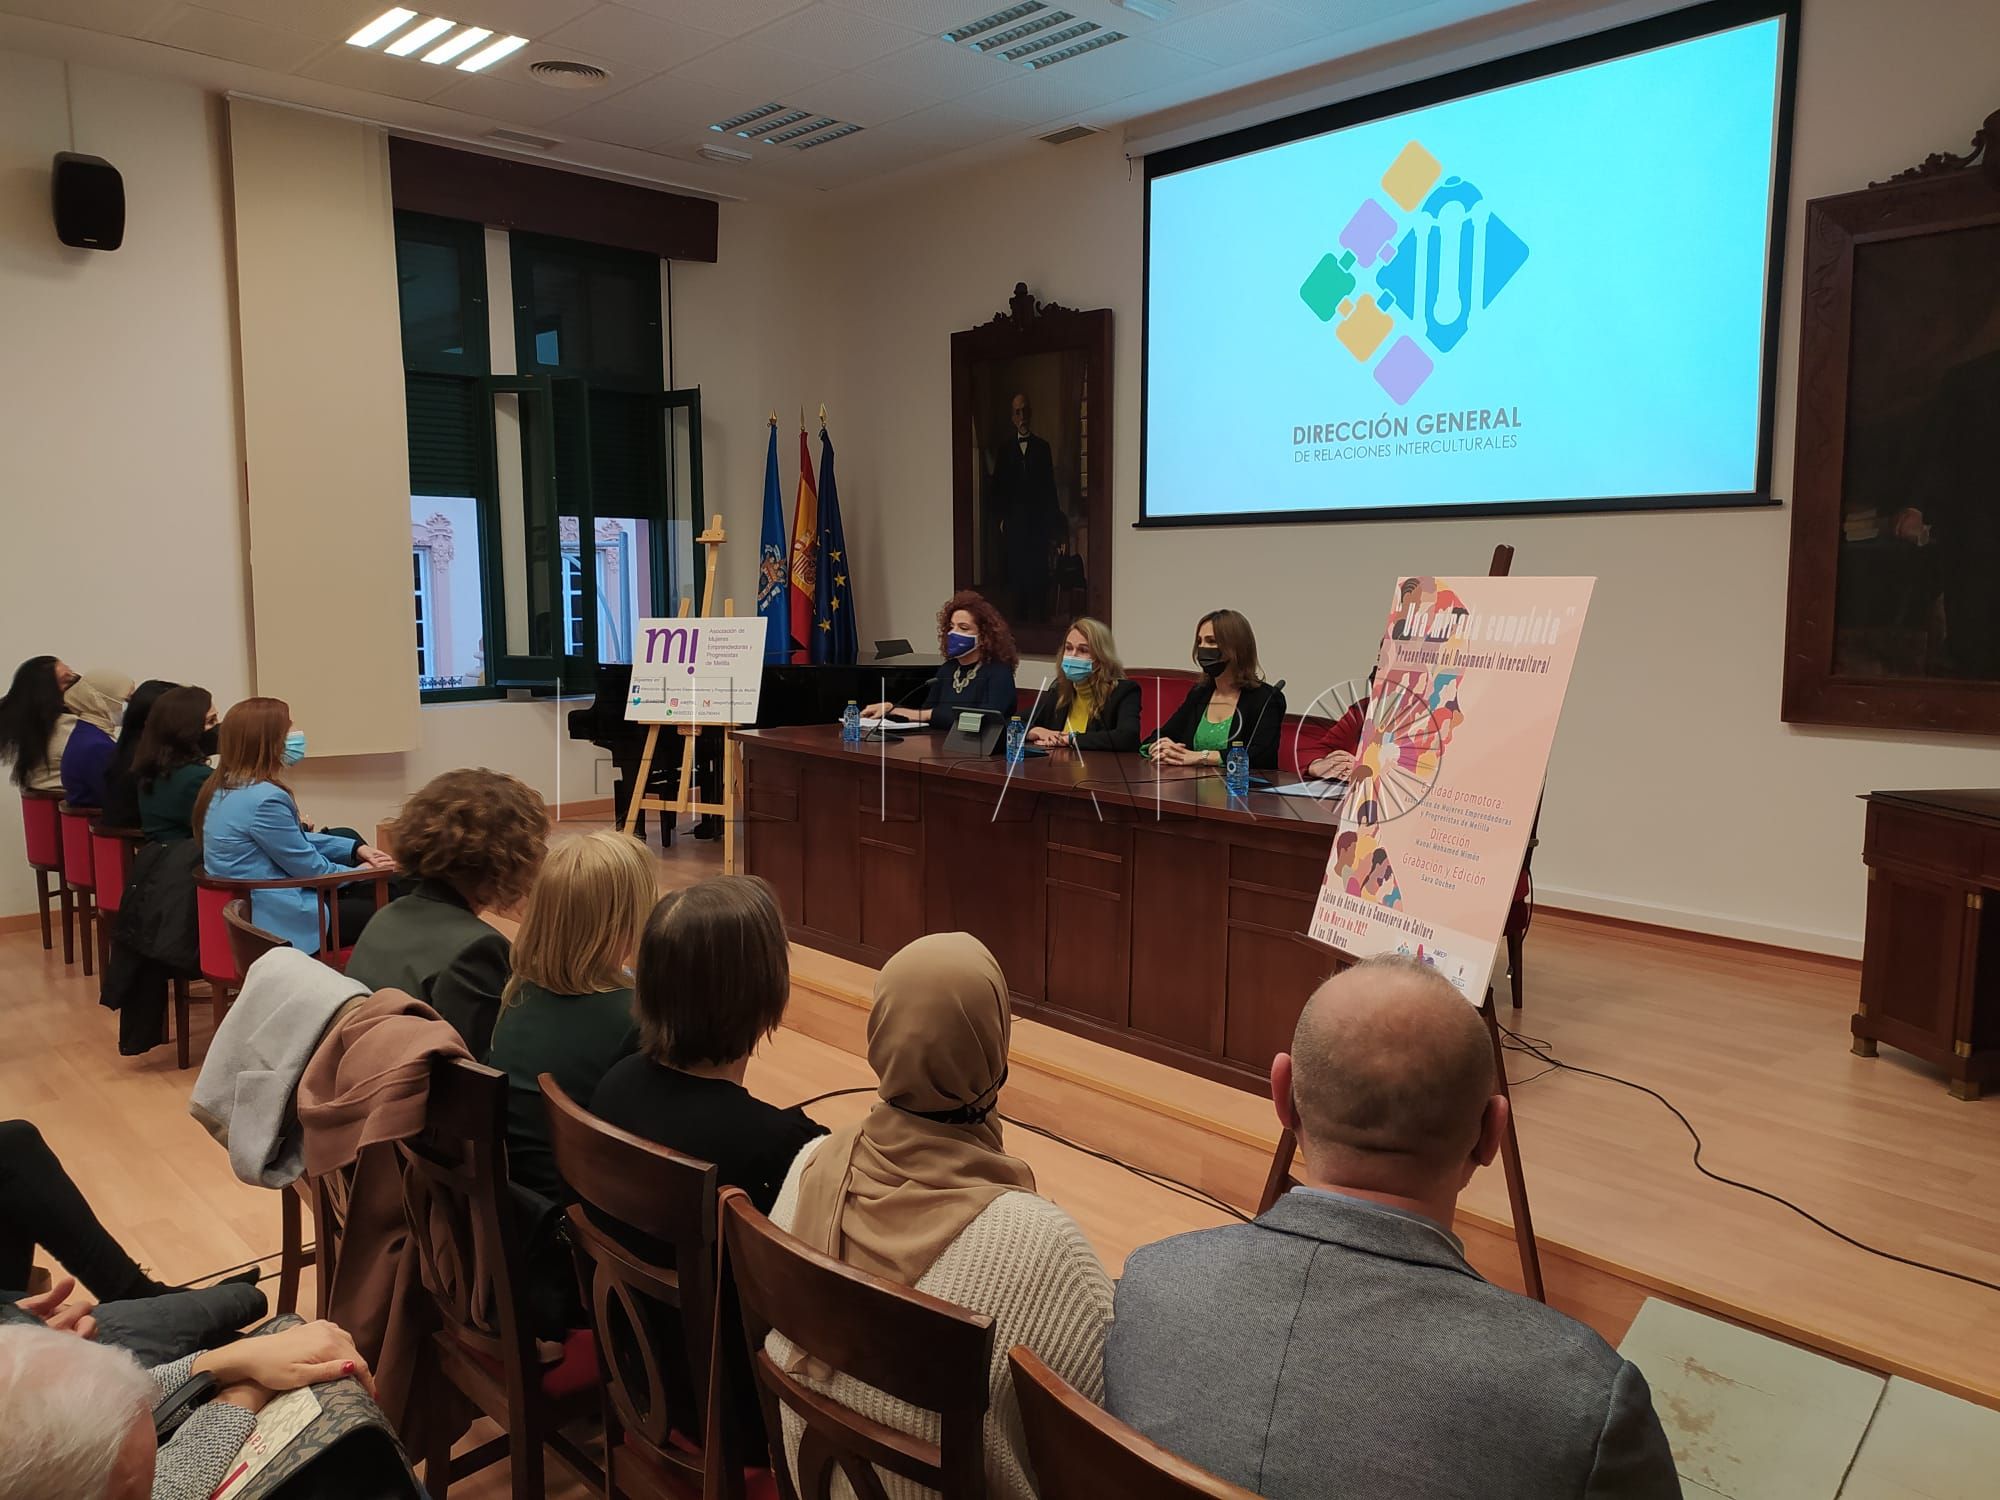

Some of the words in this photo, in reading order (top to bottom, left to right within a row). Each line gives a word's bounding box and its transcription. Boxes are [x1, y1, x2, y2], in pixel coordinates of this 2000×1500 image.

[1293, 412, 1409, 446] DIRECCIÓN
[1416, 406, 1522, 435] GENERAL
[1294, 450, 1310, 463] DE
[1313, 444, 1391, 462] RELACIONES
[1395, 434, 1518, 457] INTERCULTURALES
[1441, 647, 1453, 666] del
[1453, 649, 1496, 670] Documental
[1496, 651, 1552, 674] Intercultural
[1454, 788, 1505, 811] promotora:
[1464, 808, 1513, 826] Emprendedoras
[1469, 819, 1491, 833] Melilla
[1430, 828, 1472, 848] Dirección
